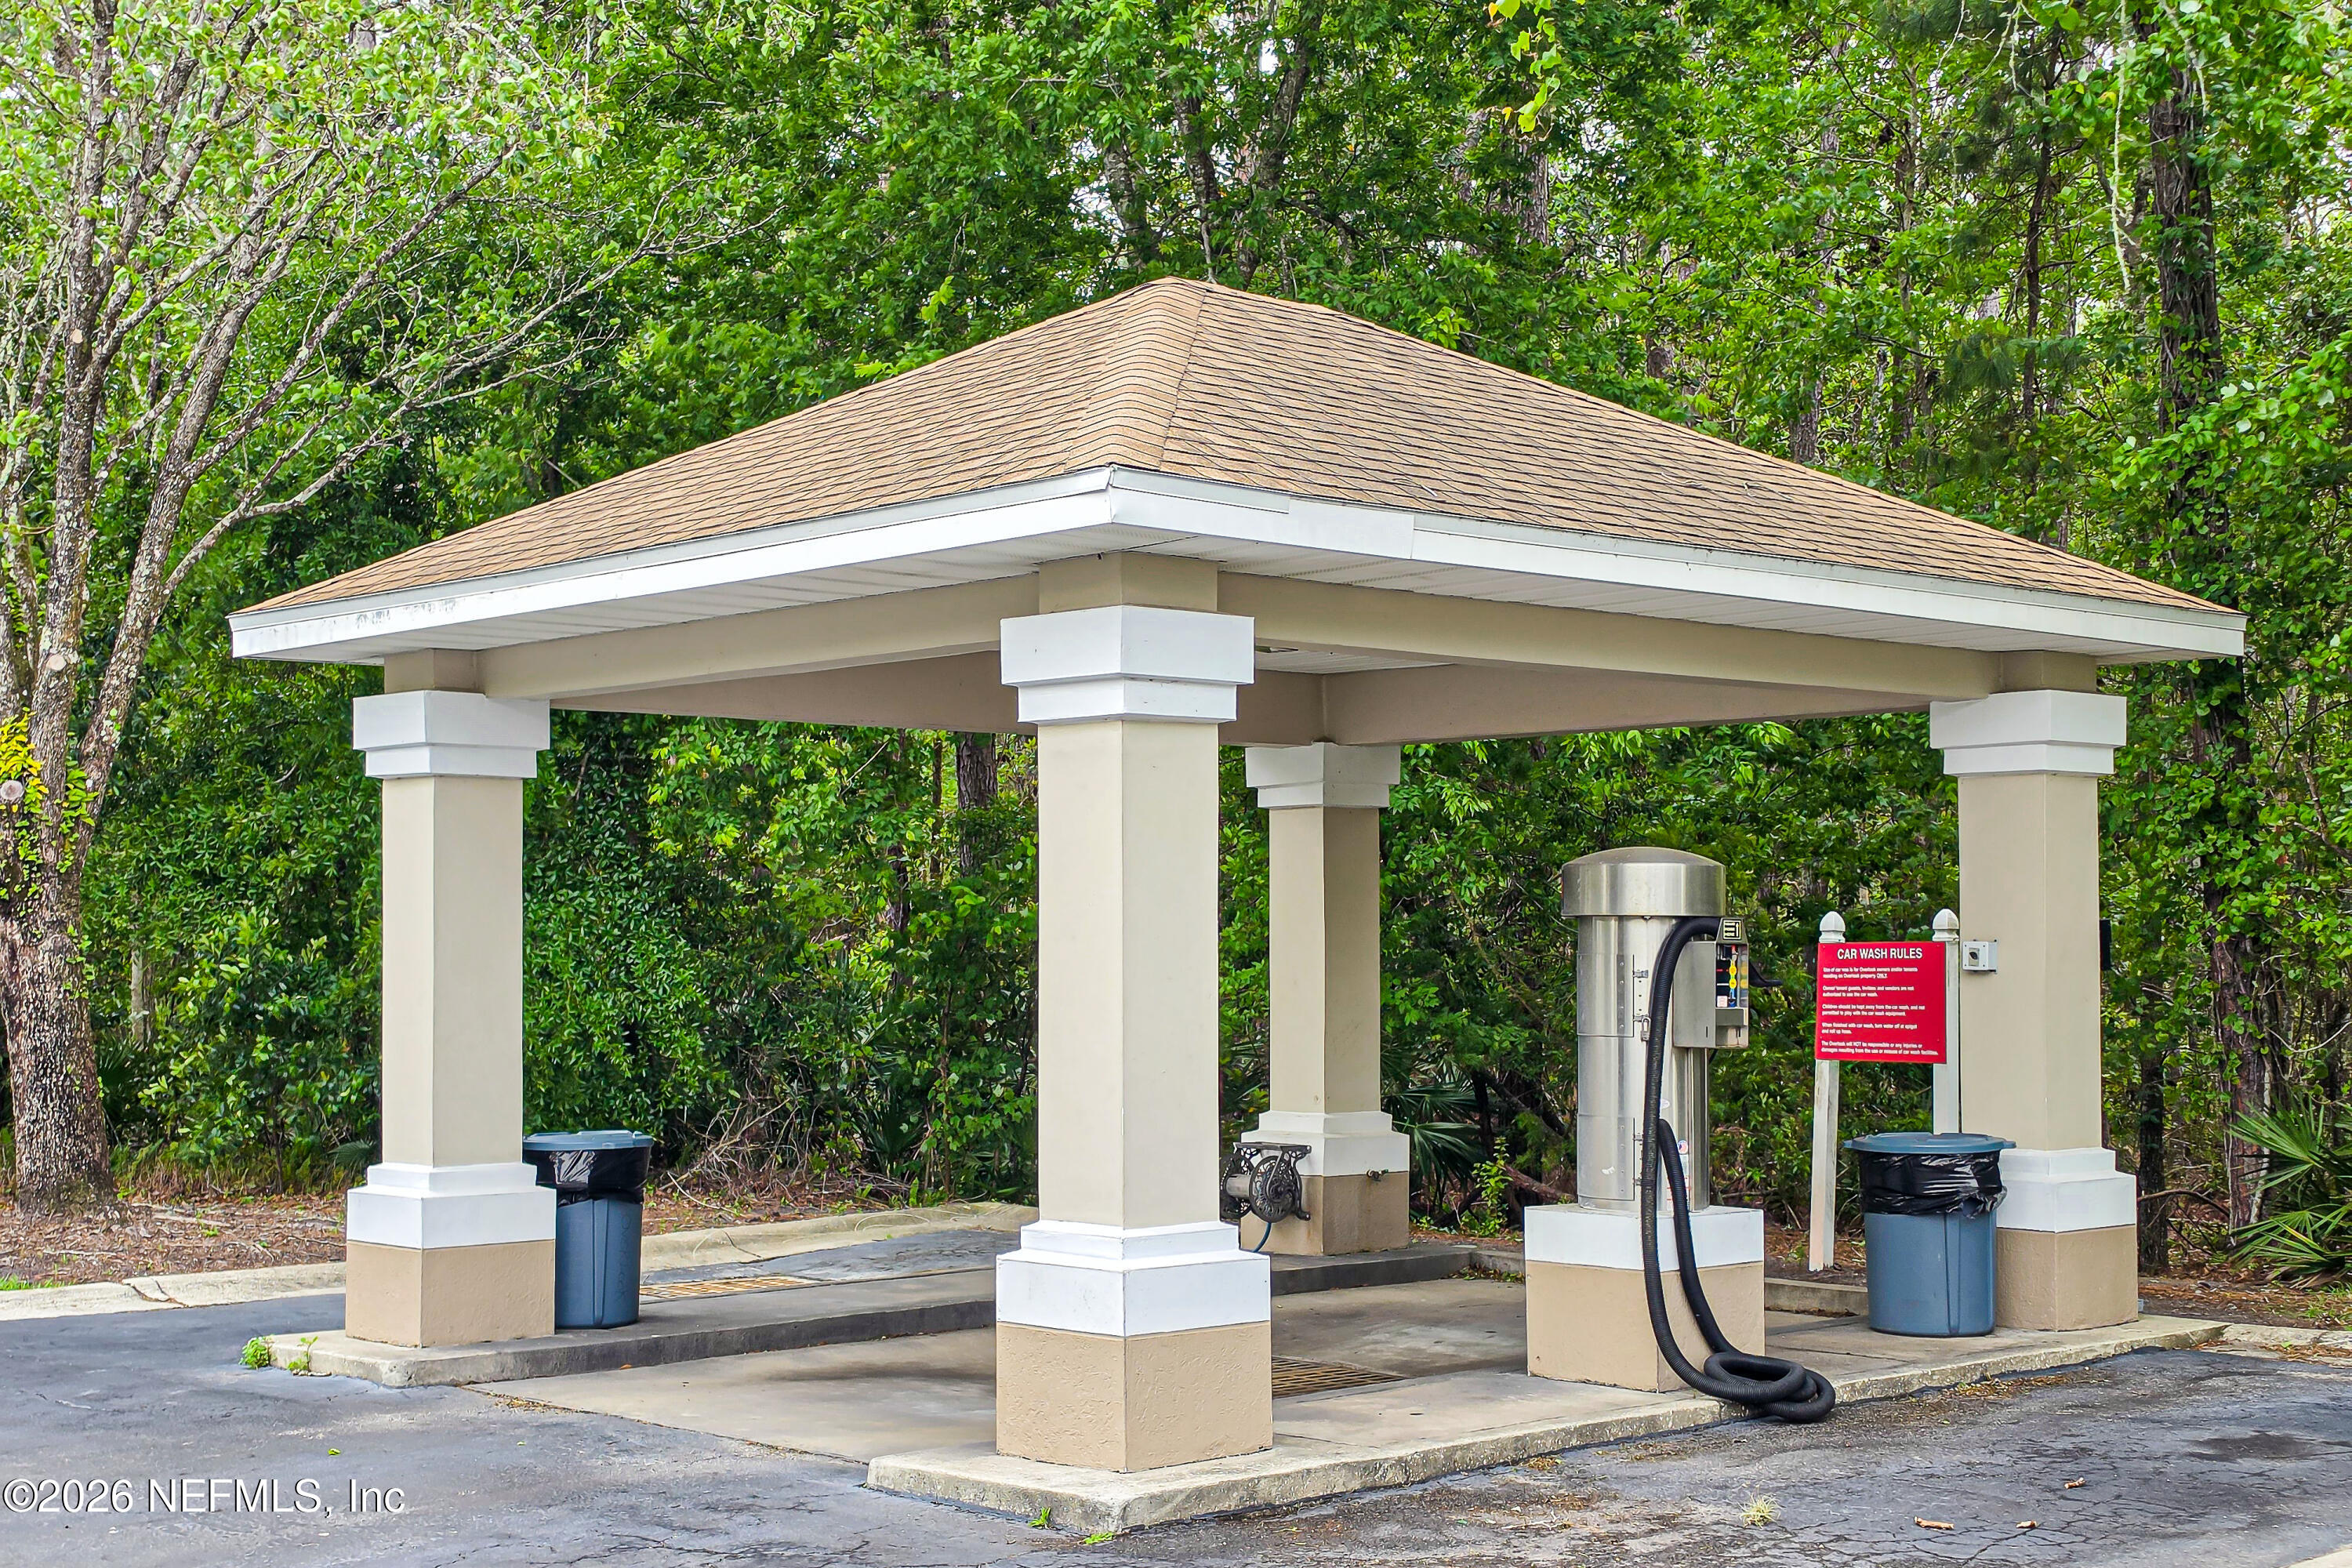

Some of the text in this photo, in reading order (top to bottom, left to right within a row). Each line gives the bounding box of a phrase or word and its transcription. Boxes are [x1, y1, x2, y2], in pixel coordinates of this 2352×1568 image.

[1837, 947, 1923, 960] CAR WASH RULES
